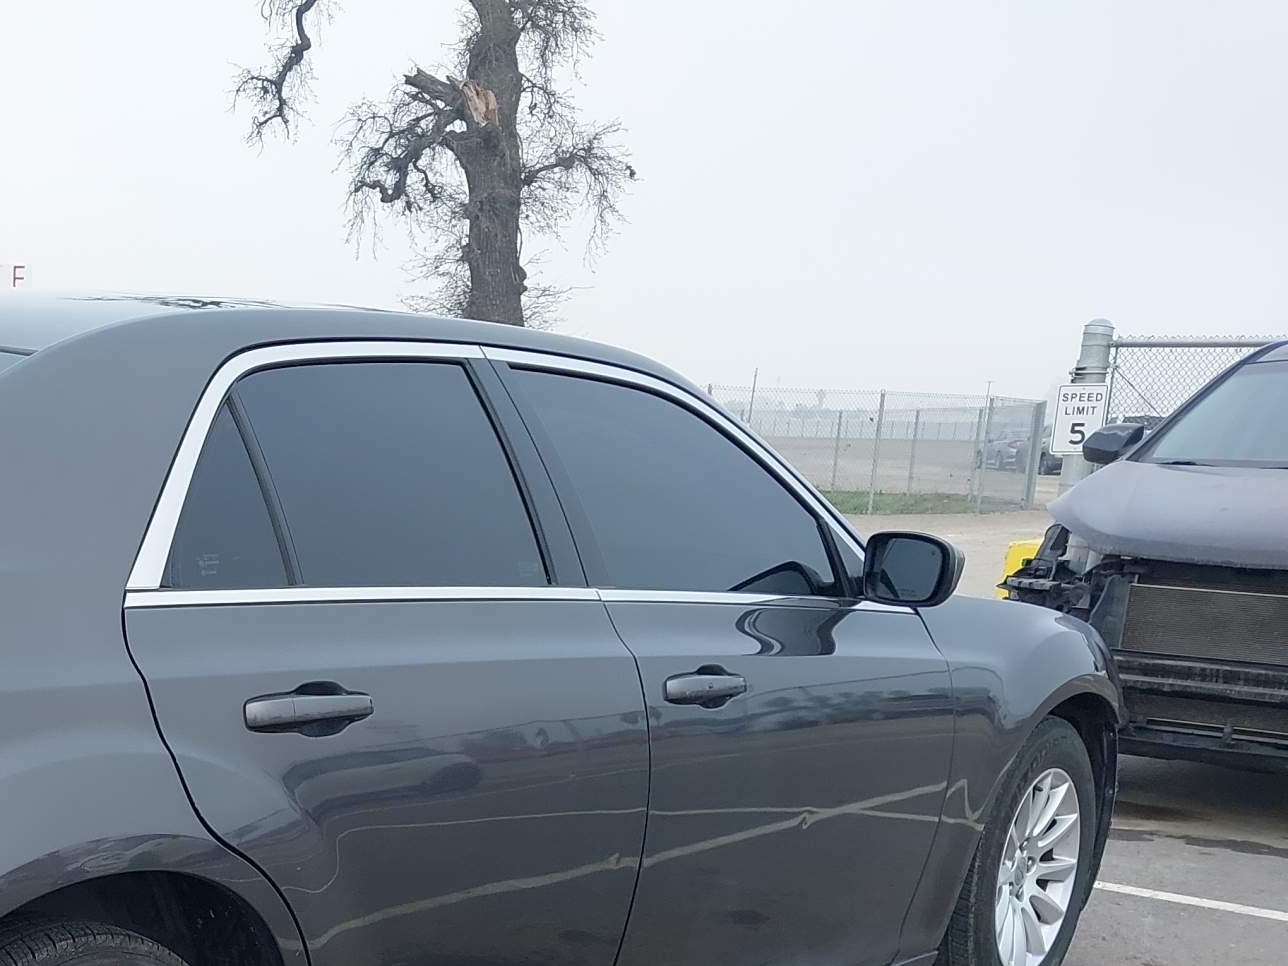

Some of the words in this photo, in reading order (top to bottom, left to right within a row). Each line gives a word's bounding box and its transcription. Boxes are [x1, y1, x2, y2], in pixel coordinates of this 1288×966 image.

[12, 264, 26, 288] F
[1062, 392, 1104, 403] SPEED
[1064, 405, 1098, 416] LIMIT
[1068, 422, 1086, 446] 5
